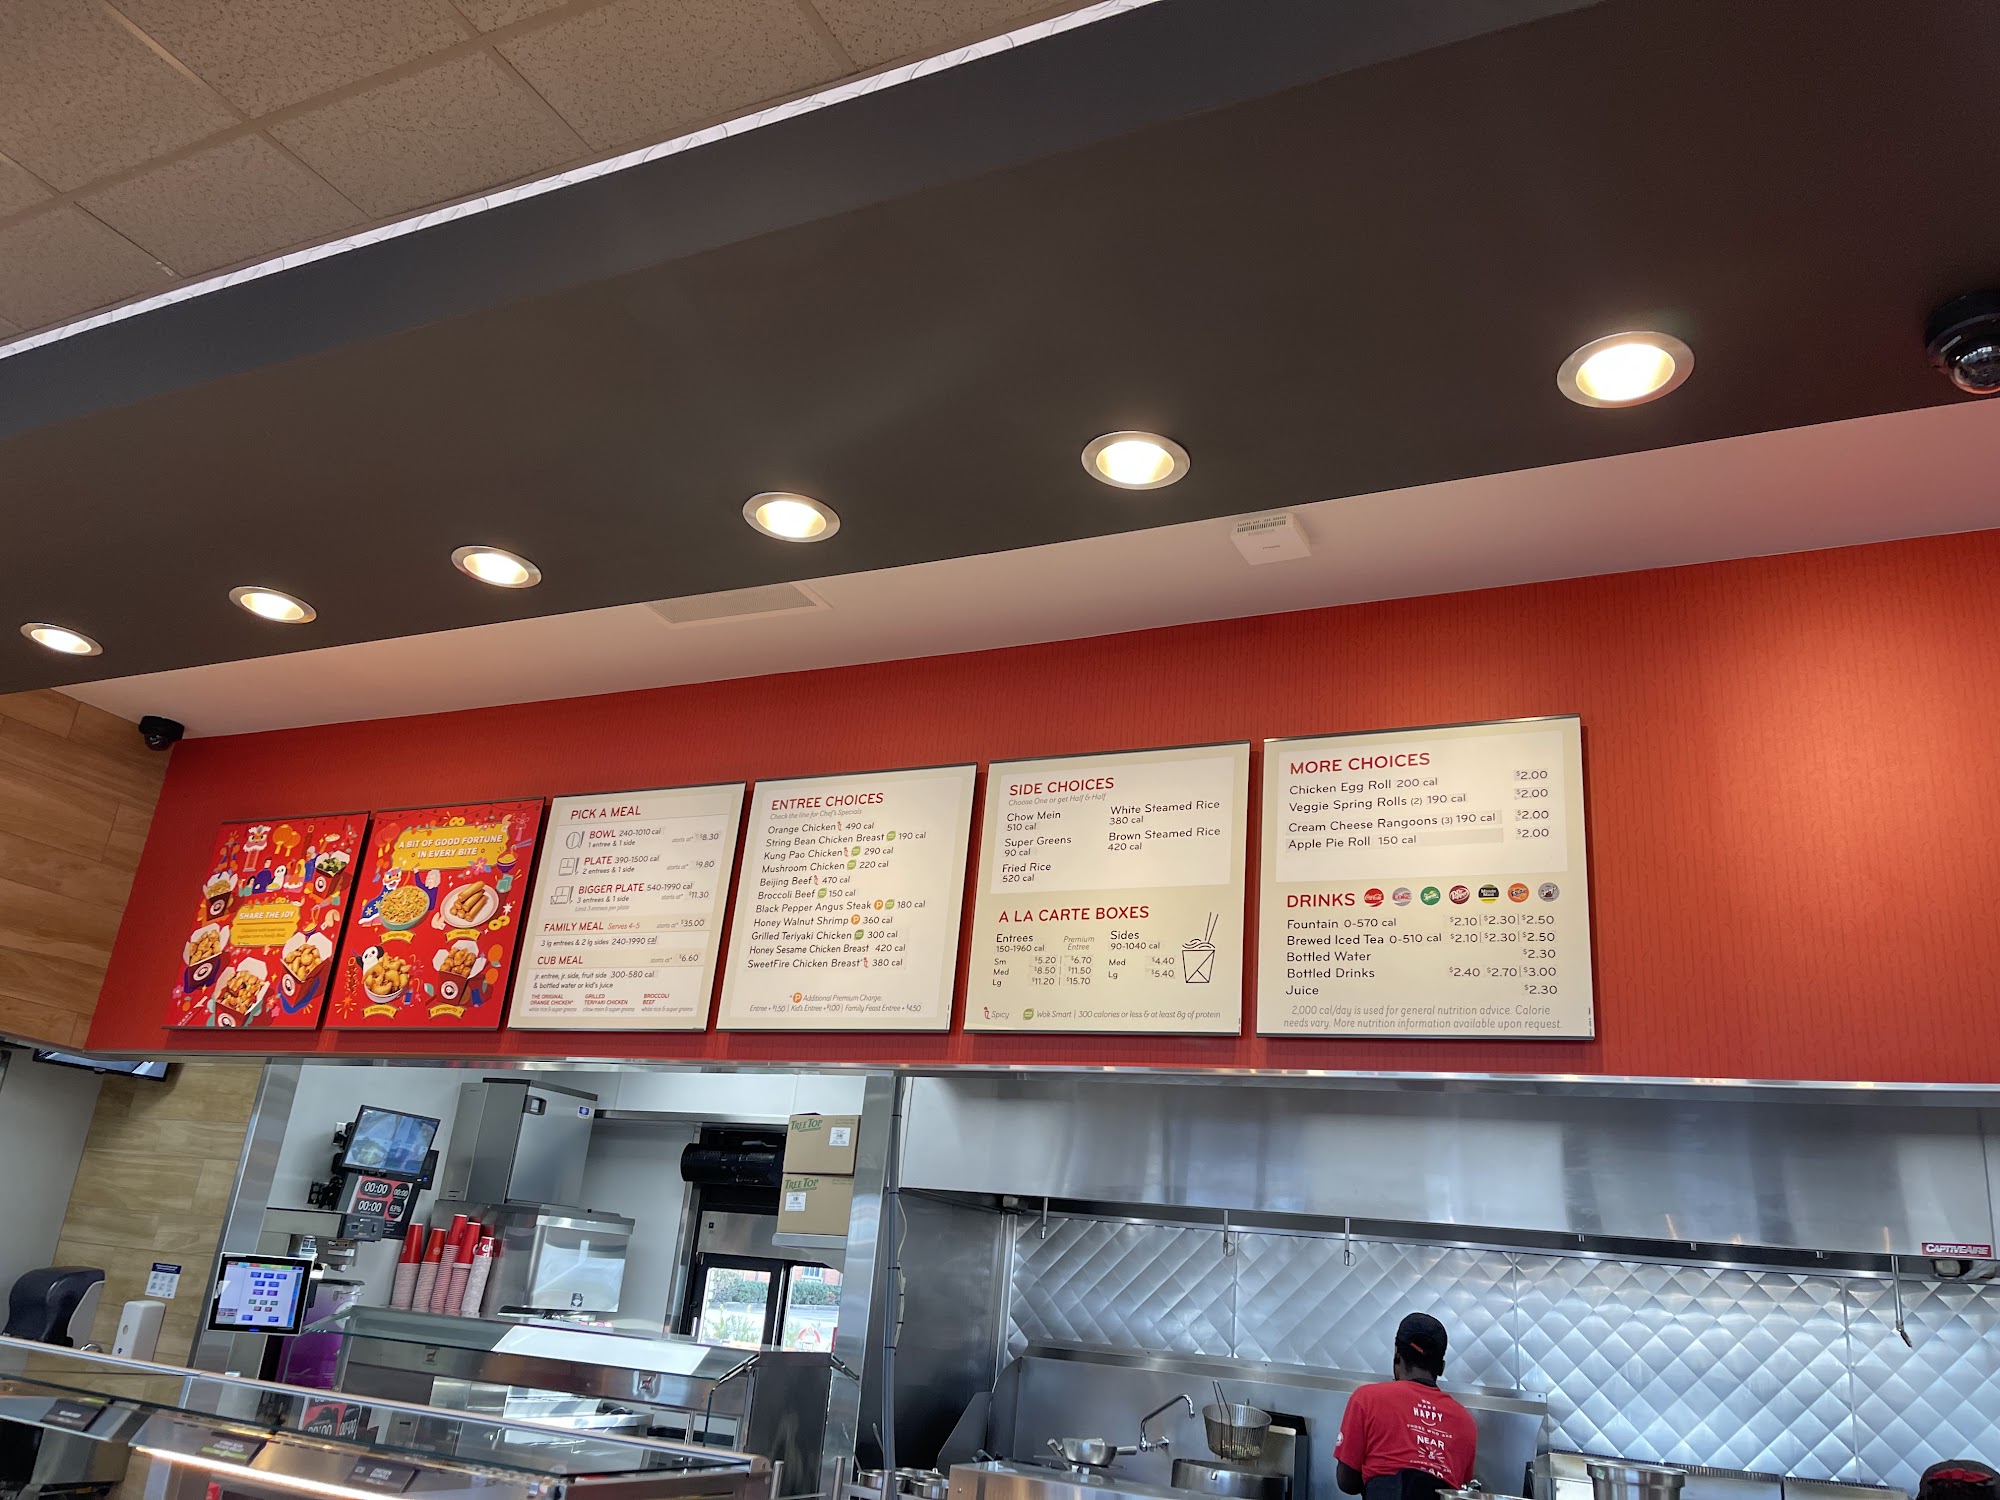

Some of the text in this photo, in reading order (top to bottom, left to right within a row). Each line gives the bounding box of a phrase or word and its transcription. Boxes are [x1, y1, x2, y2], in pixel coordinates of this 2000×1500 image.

[1290, 753, 1430, 775] MORE CHOICES
[1009, 777, 1114, 796] SIDE CHOICES
[1290, 770, 1547, 795] Chicken Egg Roll 200 cal $2.00
[772, 793, 883, 810] ENTREE CHOICES
[1289, 788, 1548, 814] Veggie Spring Rolls (2) 190 cal $2.00
[570, 806, 641, 820] PICK A MEAL
[1110, 800, 1220, 815] White Steamed Rice
[1007, 811, 1061, 822] Chow Mein
[1110, 815, 1143, 825] 380 cal
[768, 826, 799, 835] Orange
[802, 823, 836, 832] Chicken
[1007, 823, 1022, 831] 510
[435, 838, 459, 846] GOOD
[462, 834, 502, 844] FORTUNE
[590, 830, 616, 839] BOWL
[619, 829, 651, 837] 240-1010
[700, 833, 719, 841] $8.30
[766, 838, 791, 848] String
[794, 837, 815, 846] Bean
[819, 835, 853, 844] Chicken
[856, 834, 884, 842] Breast
[899, 832, 912, 840] 190
[1005, 836, 1071, 848] Super Greens
[1288, 835, 1416, 851] Apple Pie Roll 150 cal
[418, 848, 477, 858] IN EVERY BITE
[764, 851, 785, 861] Kung
[789, 850, 805, 859] Pao
[808, 849, 843, 858] Chicken
[864, 847, 880, 855] 290
[584, 856, 612, 865] PLATE
[615, 856, 648, 864] 390-1500
[761, 860, 888, 873] Mushroom Chicken 220 cal
[760, 878, 789, 887] Beijing
[791, 876, 812, 885] Beef
[822, 876, 837, 884] 470
[579, 885, 612, 894] BIGGER
[615, 884, 644, 893] PLATE
[647, 883, 681, 891] 540-1990
[689, 891, 709, 899] $11.30
[758, 891, 792, 900] Broccoli
[795, 890, 815, 898] Beef
[1287, 893, 1355, 907] DRINKS
[756, 901, 871, 913] Black Pepper Angus Steak
[239, 912, 263, 920] SHARE
[281, 910, 296, 918] JOY
[998, 906, 1149, 922] A LA CARTE BOXES
[544, 923, 576, 932] FAMILY
[579, 922, 603, 931] MEAL
[754, 916, 848, 928] Honey Walnut Shrimp
[1287, 915, 1554, 929] Fountain 0-570 cal $2.10 $2.30 $2.50
[996, 934, 1033, 942] Entrees
[1110, 931, 1139, 940] Sides
[1287, 934, 1384, 945] Brewed Iced Tea
[537, 954, 698, 965] CUB MEAL $6.60
[1287, 949, 1555, 962] Bottled Water $2.30
[1286, 985, 1319, 995] Juice
[992, 1011, 1009, 1019] Spicy
[1078, 1010, 1091, 1018] 300
[1093, 1010, 1119, 1018] calories
[1129, 1010, 1142, 1018] less
[1159, 1010, 1174, 1018] least
[1187, 1010, 1194, 1019] of
[1196, 1010, 1220, 1019] protein
[791, 1121, 807, 1130] TREE
[808, 1119, 823, 1127] TOP
[365, 1182, 388, 1194] 00:00
[785, 1180, 802, 1189] TREE
[803, 1178, 818, 1187] TOP
[358, 1200, 382, 1212] 00:00
[1413, 1407, 1443, 1422] HAPPY
[1417, 1435, 1445, 1450] NEAR
